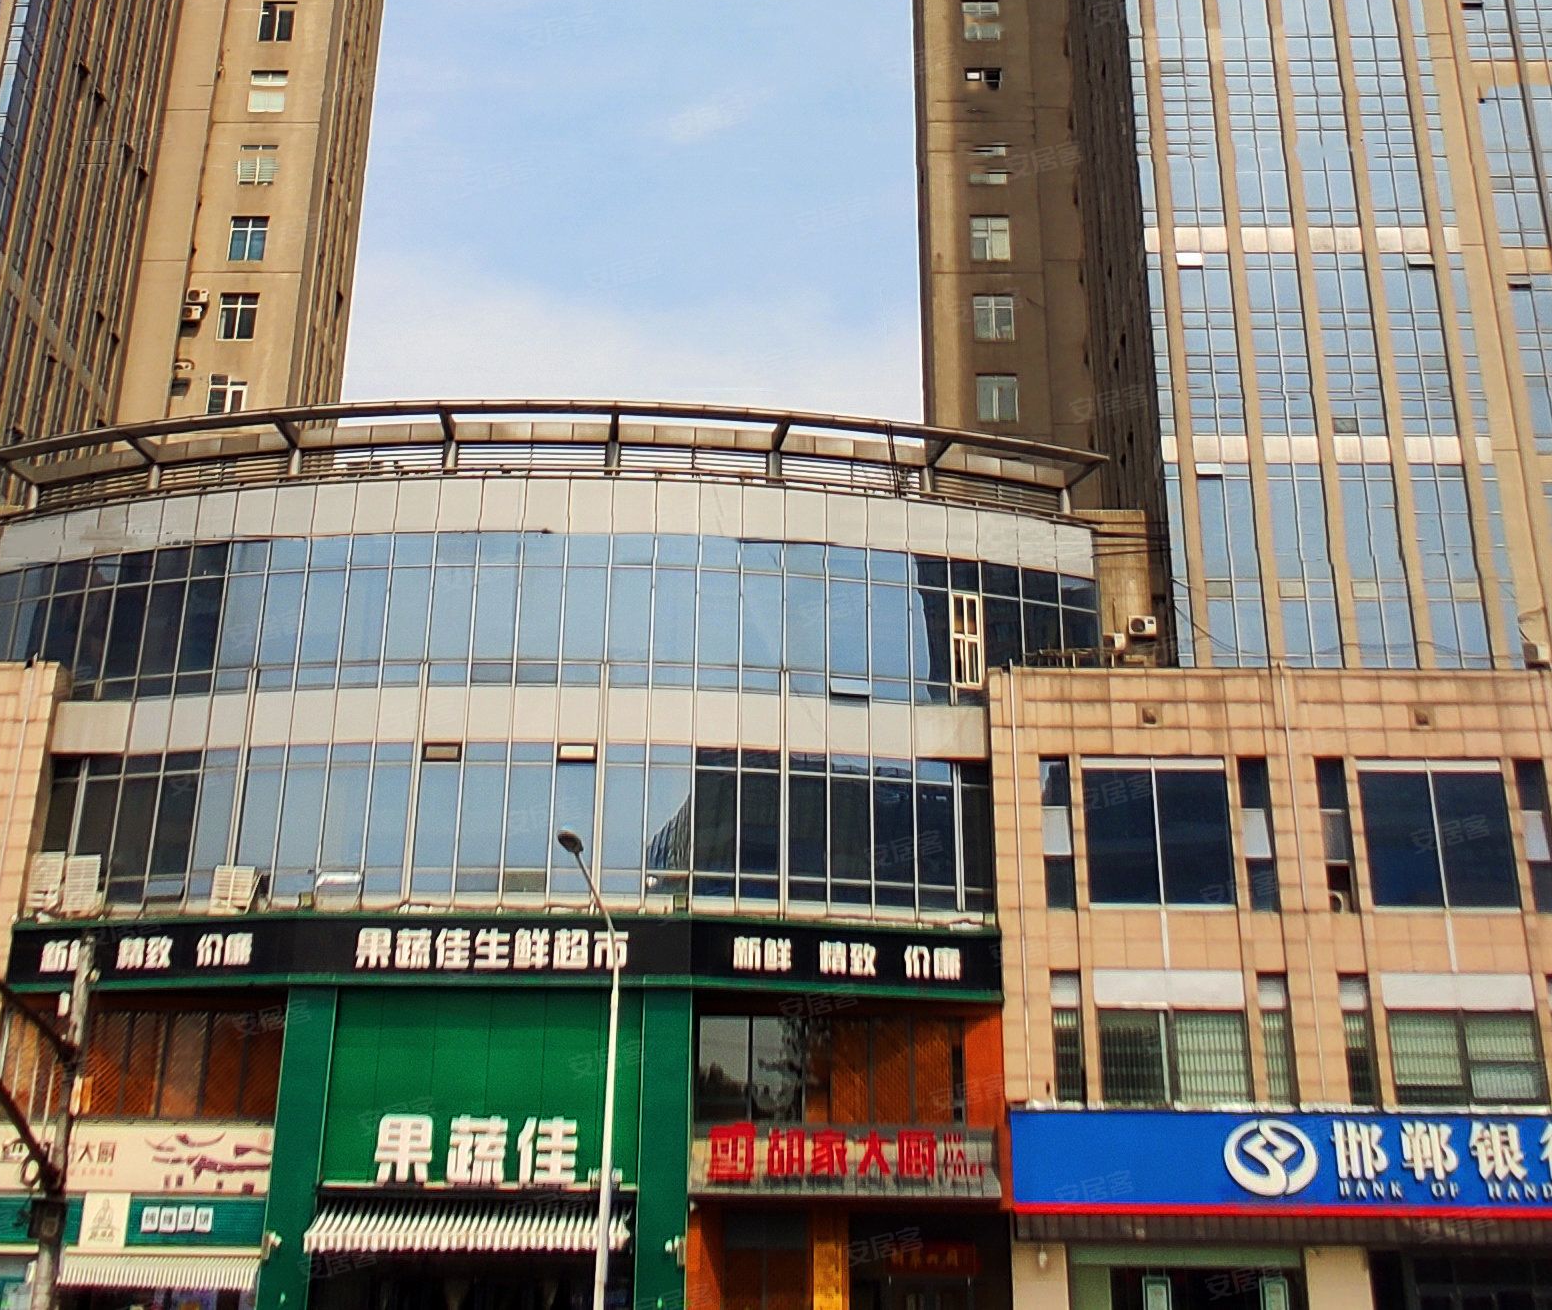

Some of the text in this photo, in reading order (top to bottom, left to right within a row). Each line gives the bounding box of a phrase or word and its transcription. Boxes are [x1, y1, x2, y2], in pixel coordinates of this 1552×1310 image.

[197, 933, 253, 967] 价廉
[354, 928, 629, 969] 果蔬佳生鲜超市
[733, 937, 960, 980] 新鲜 精致 价廉
[374, 1114, 578, 1185] 果蔬佳
[767, 1128, 937, 1178] 胡家大厨
[1338, 1181, 1405, 1201] BANK
[1431, 1181, 1460, 1201] OF
